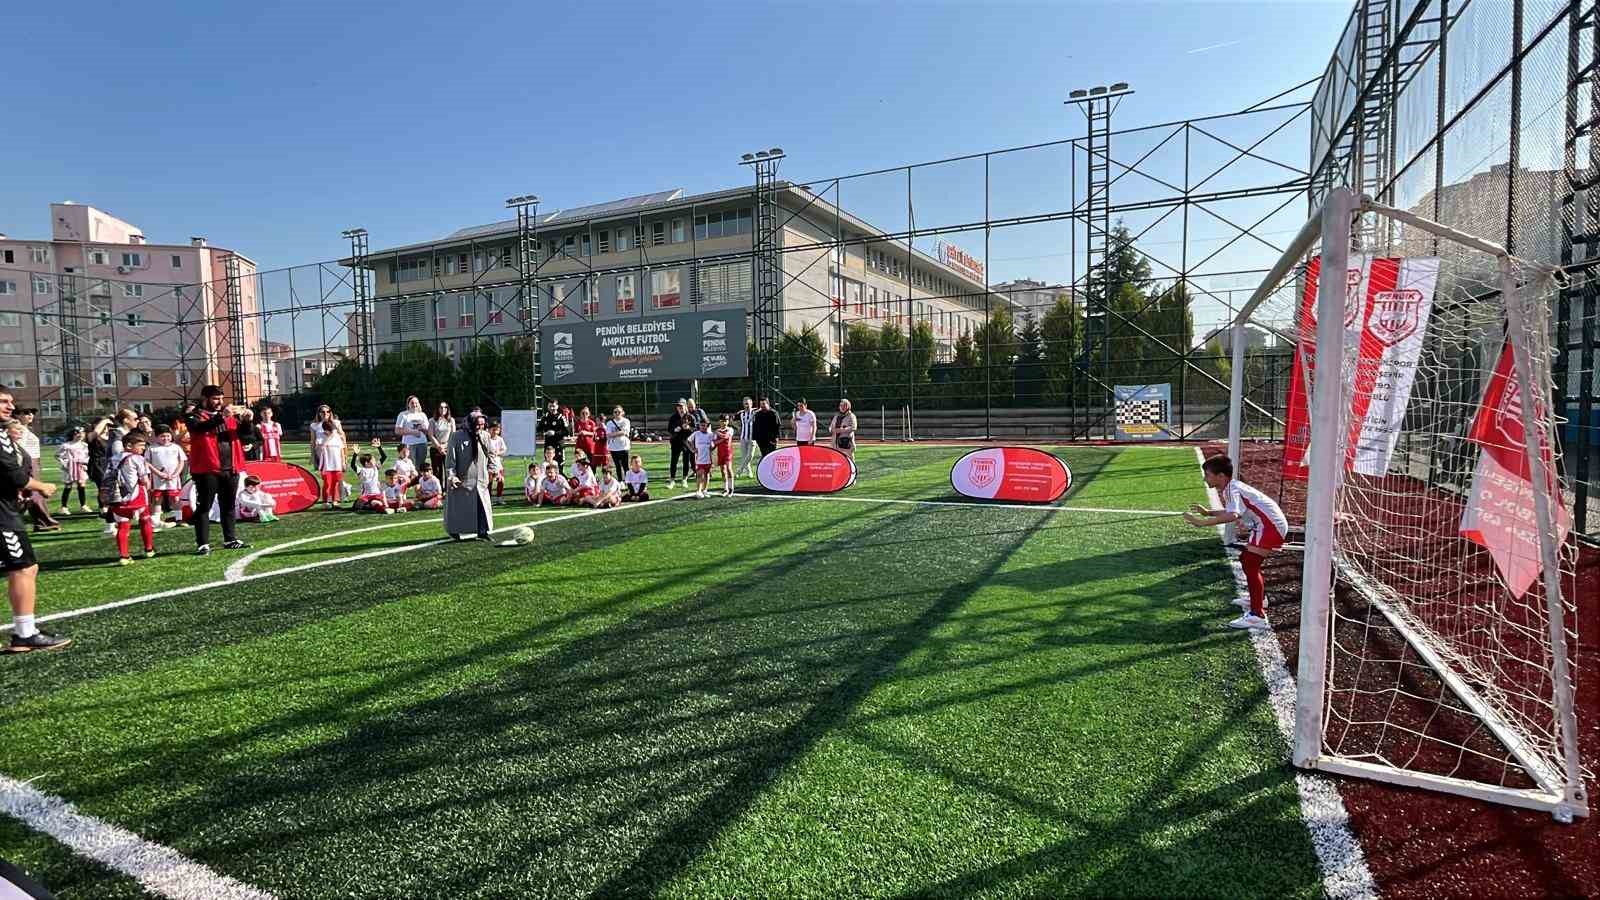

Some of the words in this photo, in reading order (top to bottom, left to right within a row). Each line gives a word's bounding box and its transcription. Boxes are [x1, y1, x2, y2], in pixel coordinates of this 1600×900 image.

[596, 323, 626, 336] PENDİK
[627, 319, 675, 333] BELEDİYESİ
[602, 336, 635, 346] AMPUTE
[637, 333, 670, 344] FUTBOL
[611, 346, 660, 357] TAKIMIMIZA
